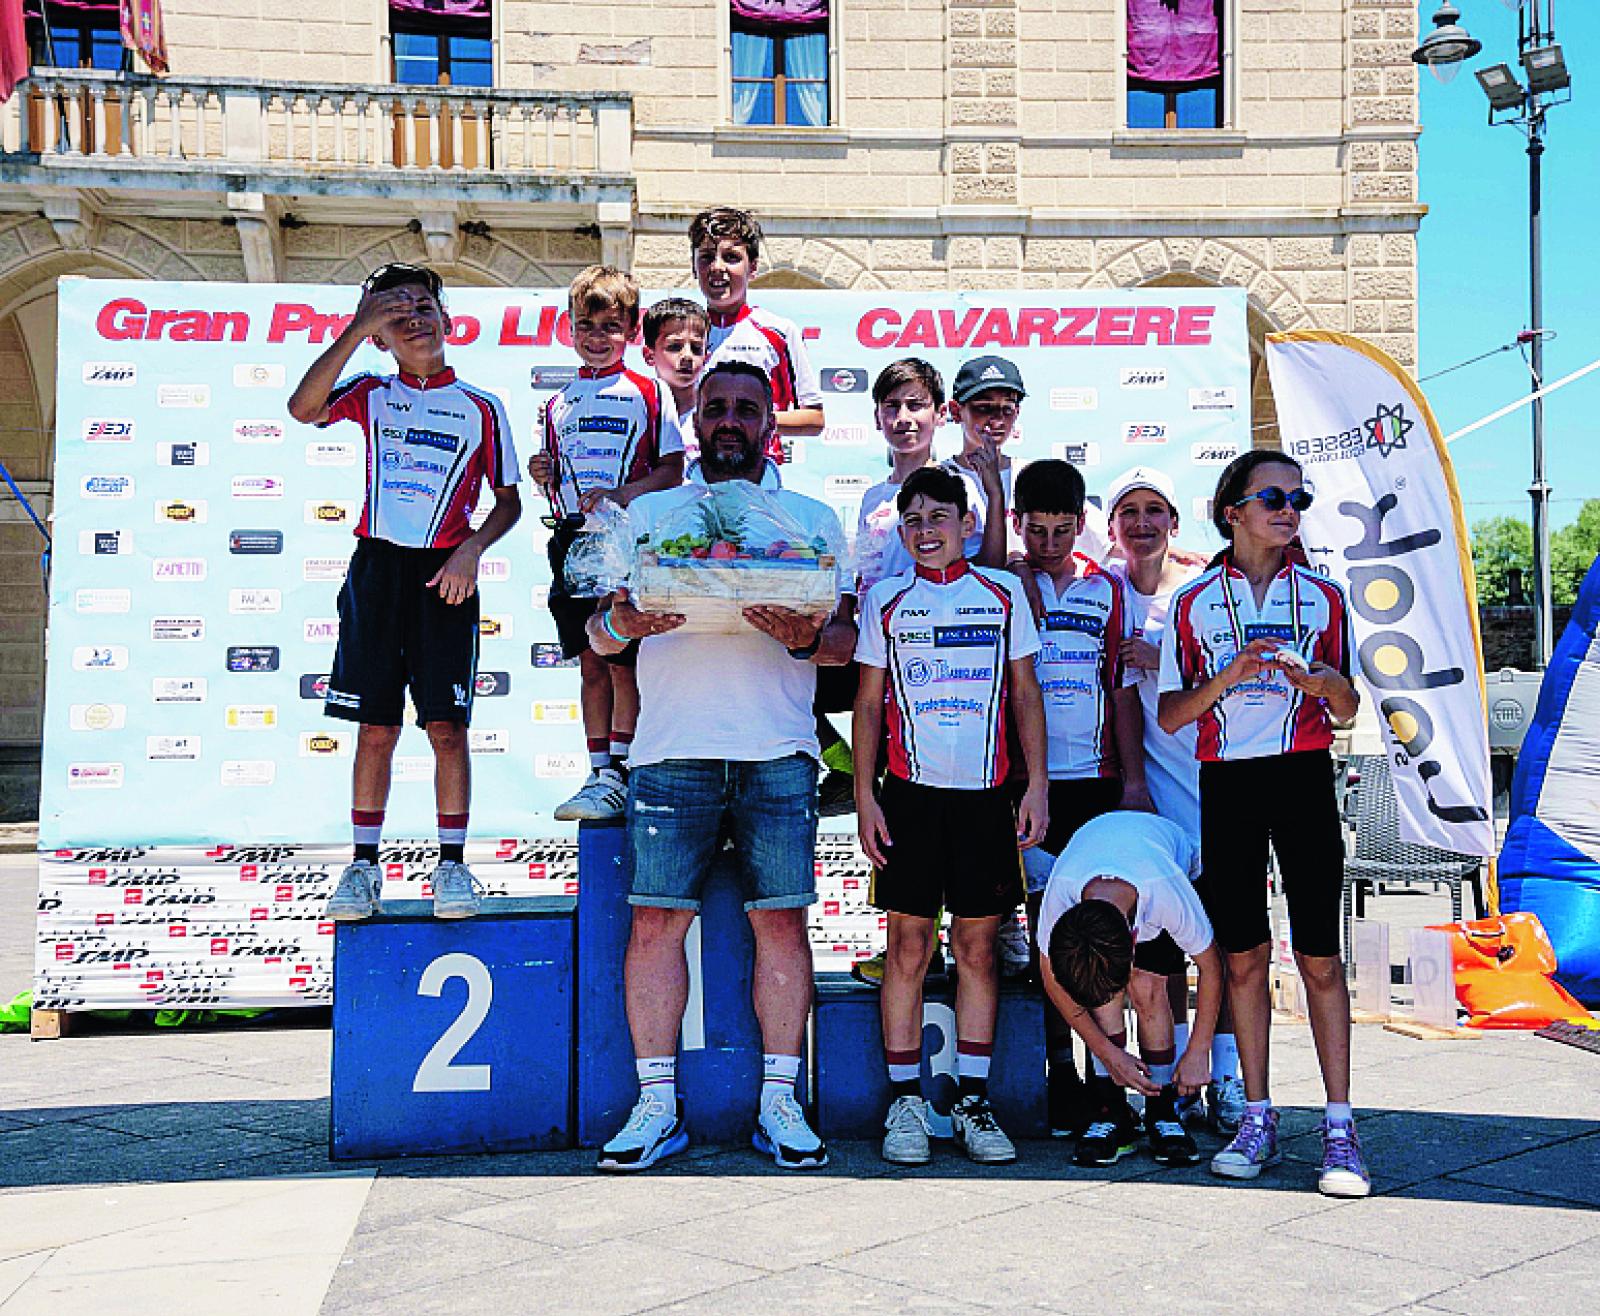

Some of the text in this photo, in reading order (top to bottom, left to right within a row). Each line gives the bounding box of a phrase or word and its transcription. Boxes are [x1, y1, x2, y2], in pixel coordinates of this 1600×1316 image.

[96, 297, 250, 341] Gran
[856, 305, 1216, 348] CAVARZERE
[413, 952, 493, 1093] 2
